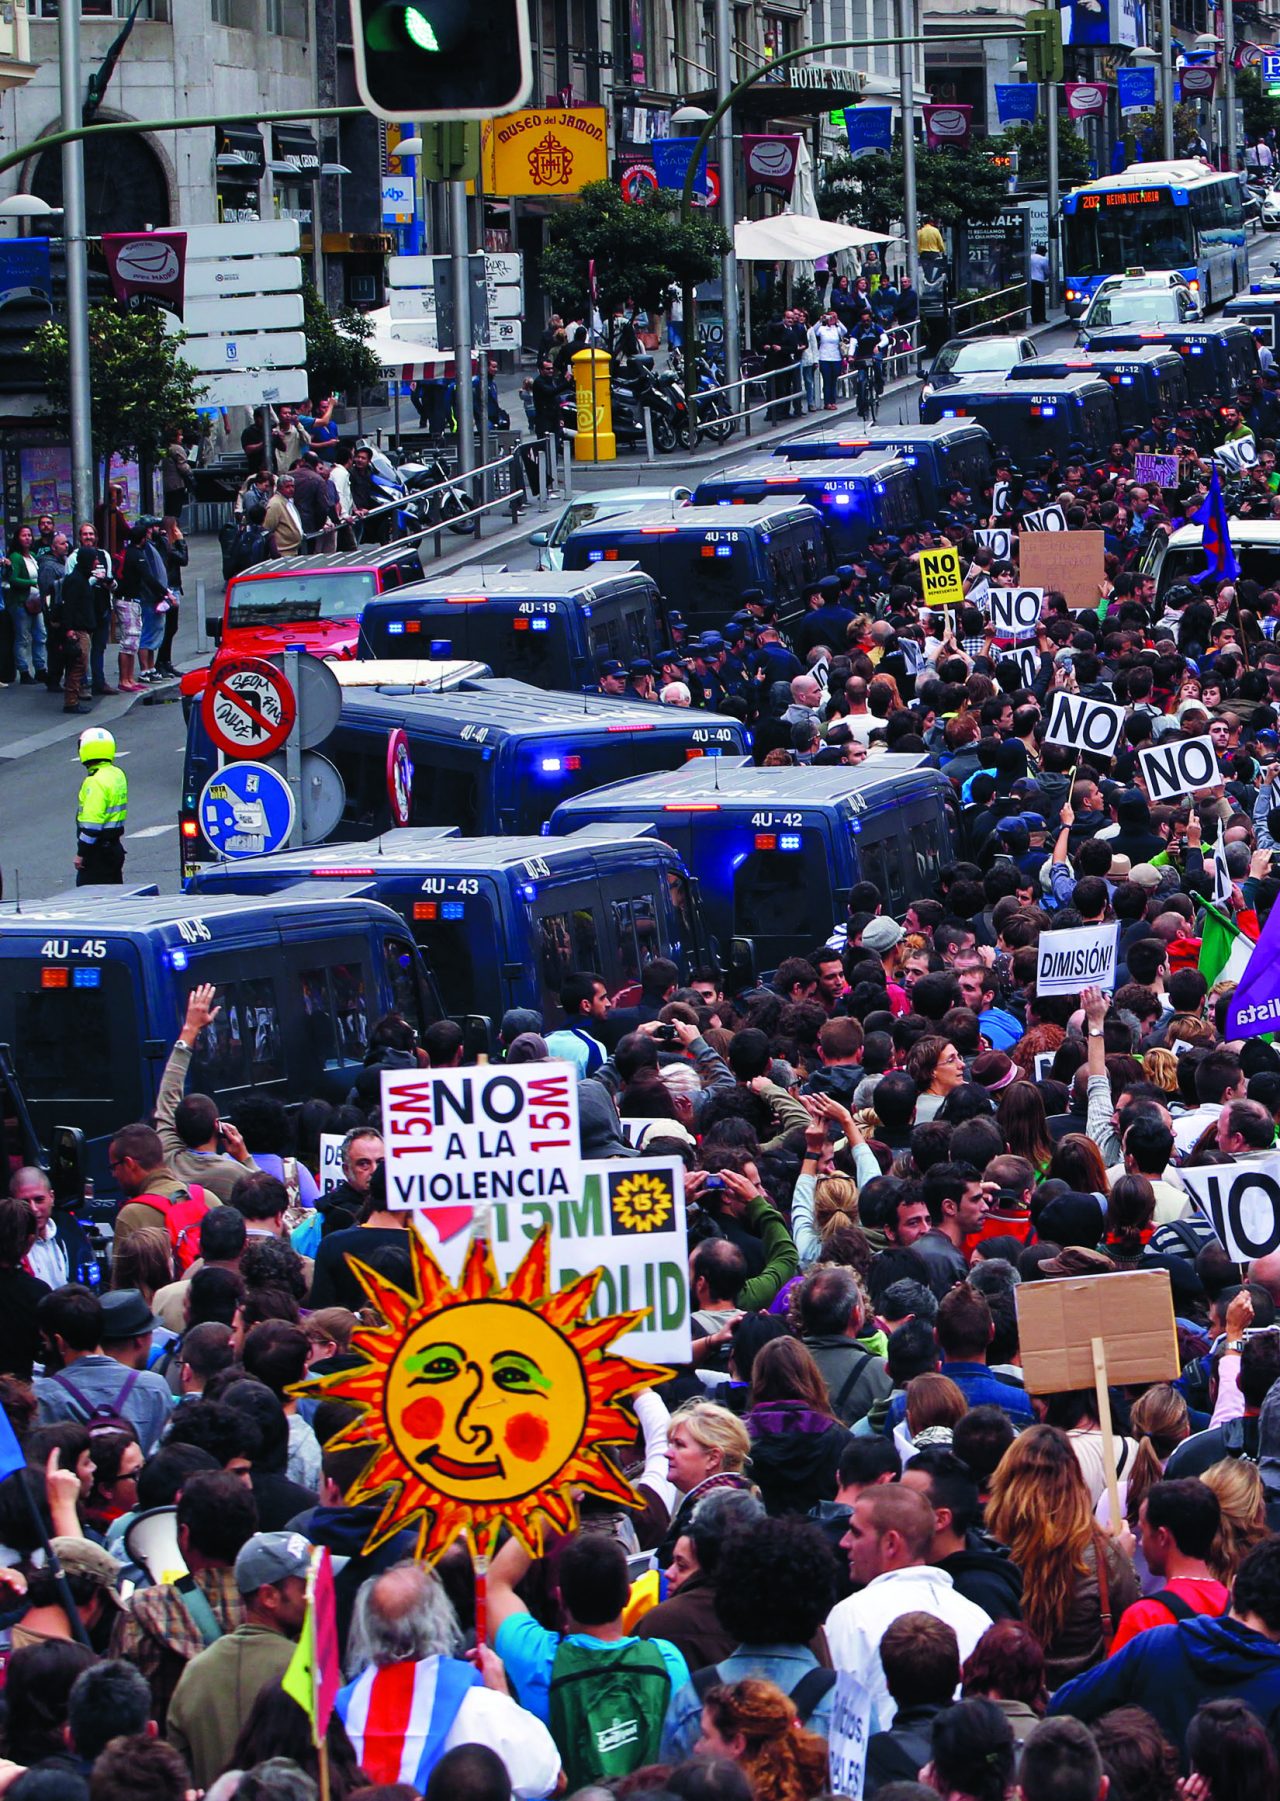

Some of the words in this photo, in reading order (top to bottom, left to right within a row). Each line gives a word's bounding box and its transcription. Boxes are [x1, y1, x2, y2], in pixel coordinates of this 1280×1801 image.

[790, 67, 829, 89] HOTEL
[498, 114, 541, 144] MUSEO
[543, 116, 557, 126] del
[701, 325, 724, 342] NO
[1221, 441, 1258, 473] NO
[824, 481, 855, 491] 4U-16
[705, 531, 739, 541] 4U-18
[975, 532, 1010, 559] NO
[924, 554, 955, 575] NO
[926, 574, 957, 589] NOS
[519, 603, 556, 613] 4U-19
[991, 591, 1040, 627] NO
[692, 729, 732, 742] 4U-40
[1050, 696, 1118, 750] NO
[1144, 740, 1214, 796] NO
[751, 813, 802, 827] 4U-42
[421, 877, 480, 895] 4U-43
[41, 940, 107, 959] 4U-45
[1040, 941, 1112, 979] DIMISIÓN!
[432, 1075, 525, 1126] NO
[527, 1075, 571, 1153] 15M
[388, 1081, 433, 1159] 15M
[446, 1132, 466, 1160] A
[478, 1130, 516, 1158] LA
[394, 1167, 569, 1203] VIOLENCIA
